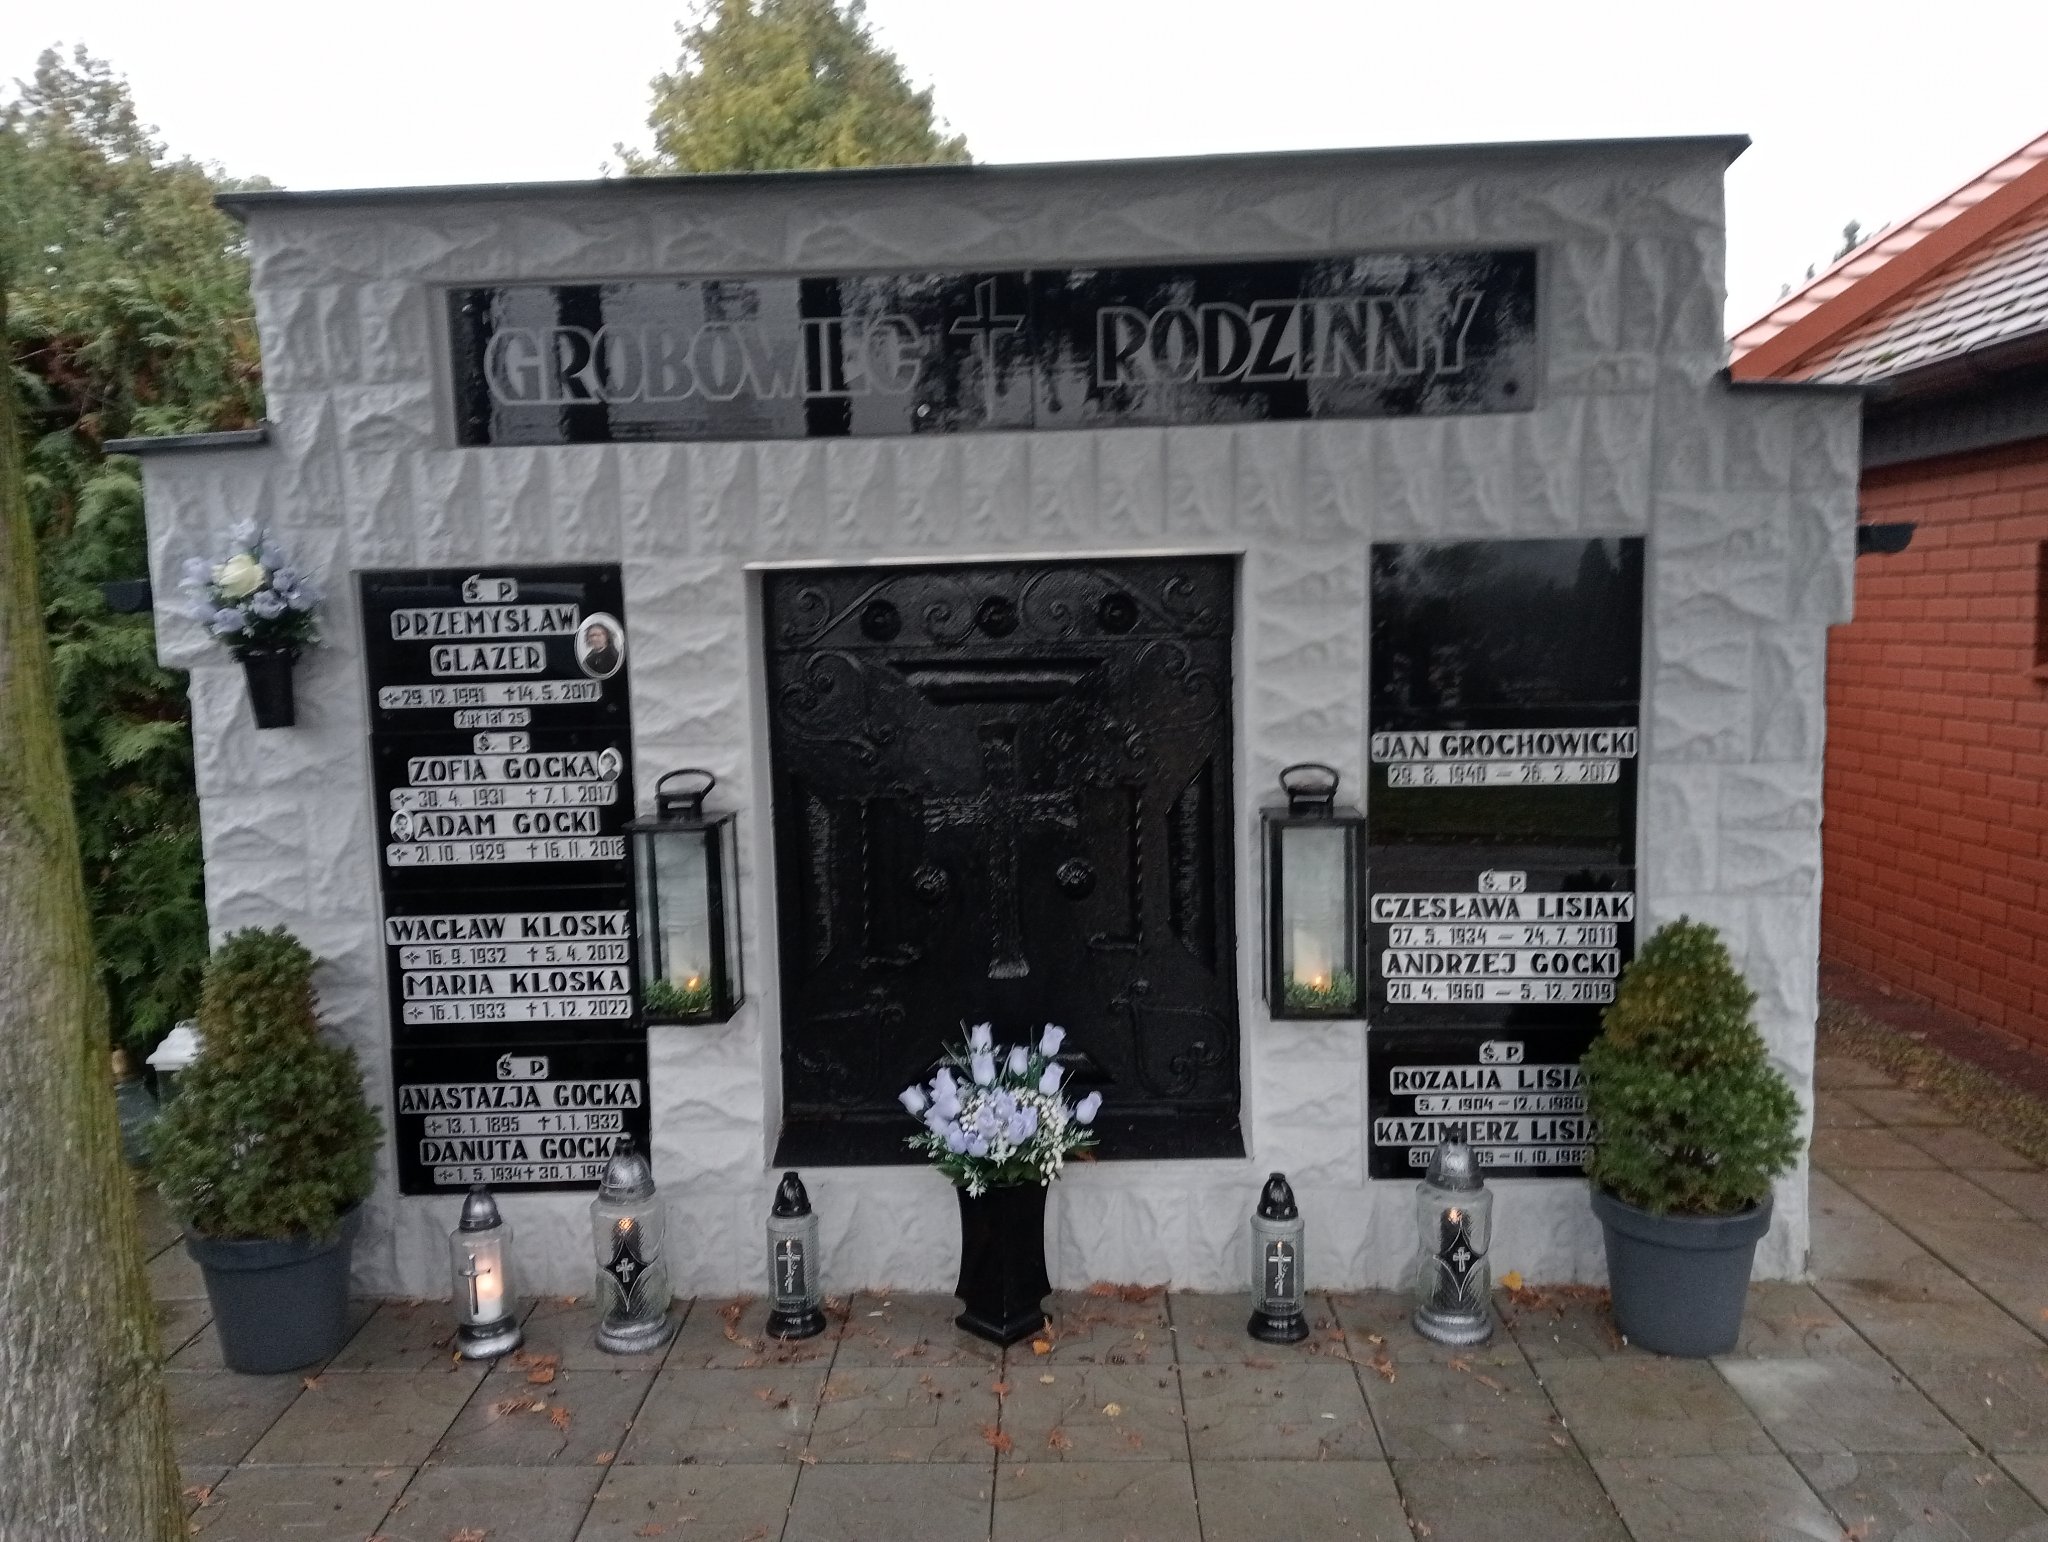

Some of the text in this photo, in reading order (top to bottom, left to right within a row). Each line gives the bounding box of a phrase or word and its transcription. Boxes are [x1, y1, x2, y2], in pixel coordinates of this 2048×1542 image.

[484, 289, 1485, 406] GROBOWIEC RODZINNY
[395, 606, 577, 637] PRZEMYSŁAW
[433, 645, 543, 671] GLAZER
[508, 711, 525, 723] 25
[1373, 731, 1634, 758] JAN GROCHOWICKI
[410, 754, 597, 785] ZOFIA GOCKA
[1580, 761, 1617, 781] 2017
[472, 787, 505, 806] 1931
[578, 784, 613, 803] 2017
[417, 808, 597, 839] ADAM GOCKI
[468, 843, 505, 861] 1929
[1374, 895, 1634, 919] CZESŁAWA LISIAK
[388, 918, 506, 942] WACŁAW
[1576, 926, 1614, 945] 2011
[469, 946, 507, 965] 1932
[586, 943, 625, 961] 2012
[1385, 952, 1616, 975] ANDRZEJ GOCKI
[405, 970, 624, 997] MARIA KLOSKA
[1446, 982, 1484, 1000] 1960
[1570, 983, 1612, 1000] 2019
[469, 1003, 506, 1020] 1933
[587, 999, 629, 1017] 2022
[1392, 1070, 1501, 1091] ROZALIA
[400, 1081, 639, 1111] ANASTAZJA GOCKA
[1376, 1121, 1519, 1142] KAZIMIERZ
[421, 1135, 617, 1163] DANUTA GOCK
